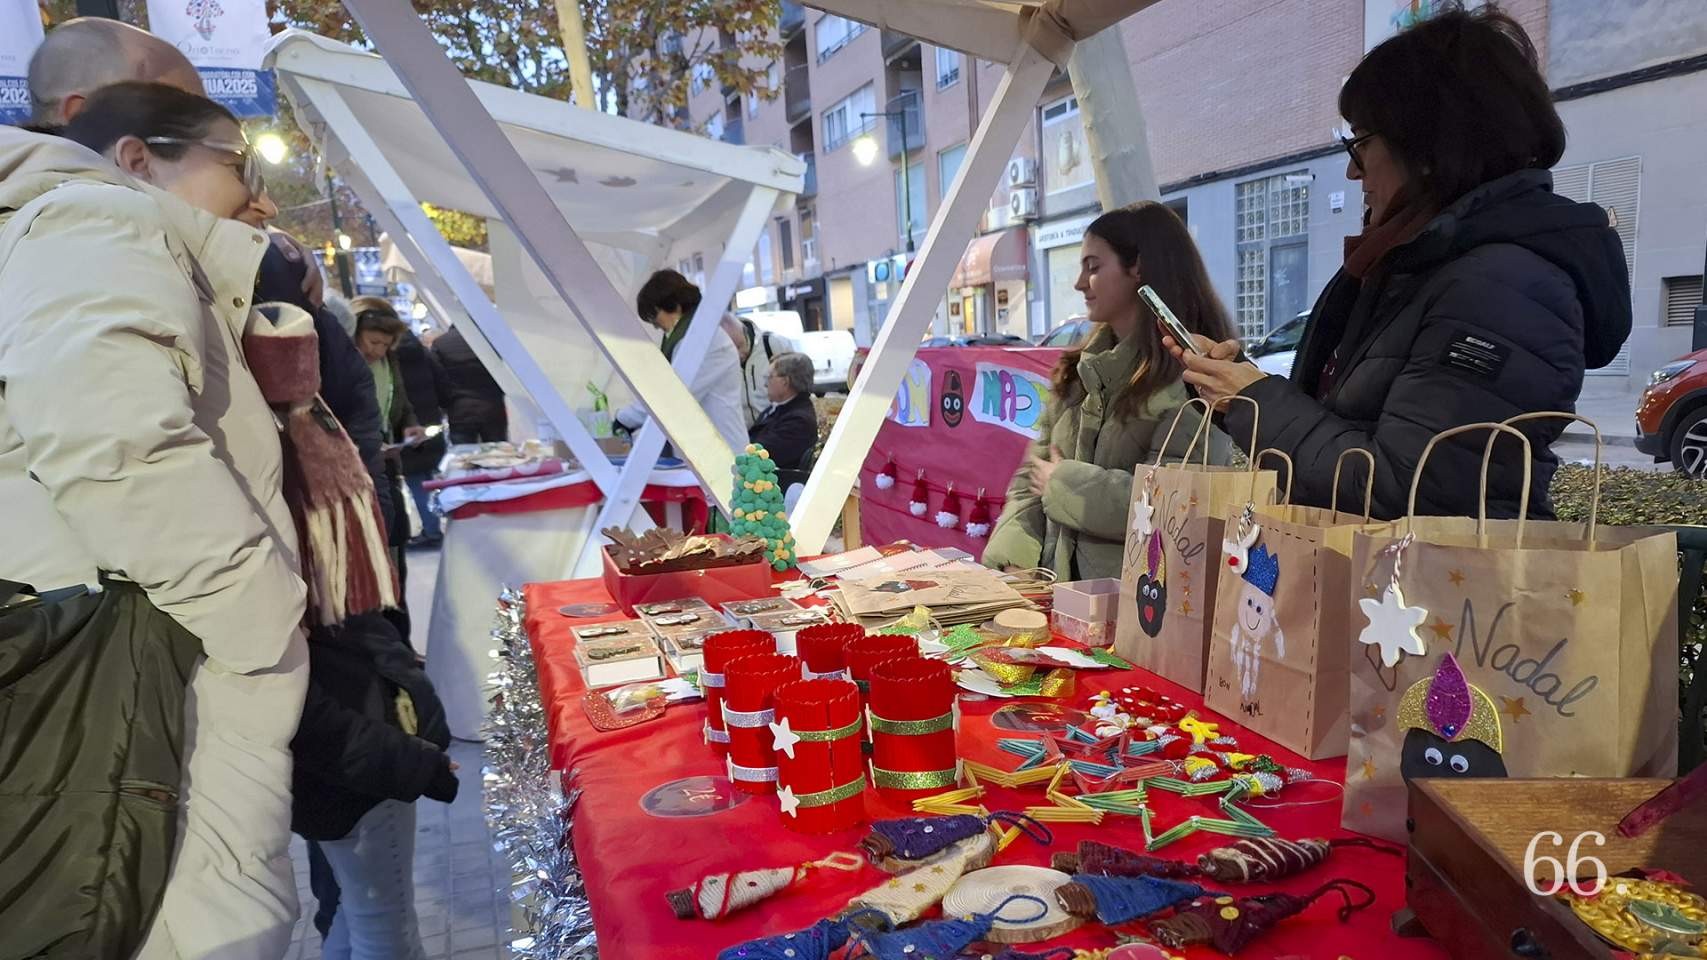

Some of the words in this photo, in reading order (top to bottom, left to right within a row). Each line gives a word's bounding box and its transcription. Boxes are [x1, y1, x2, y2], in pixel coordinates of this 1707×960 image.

[203, 79, 258, 94] UA2025
[1161, 490, 1205, 566] Nadal
[1455, 598, 1599, 717] Nadal
